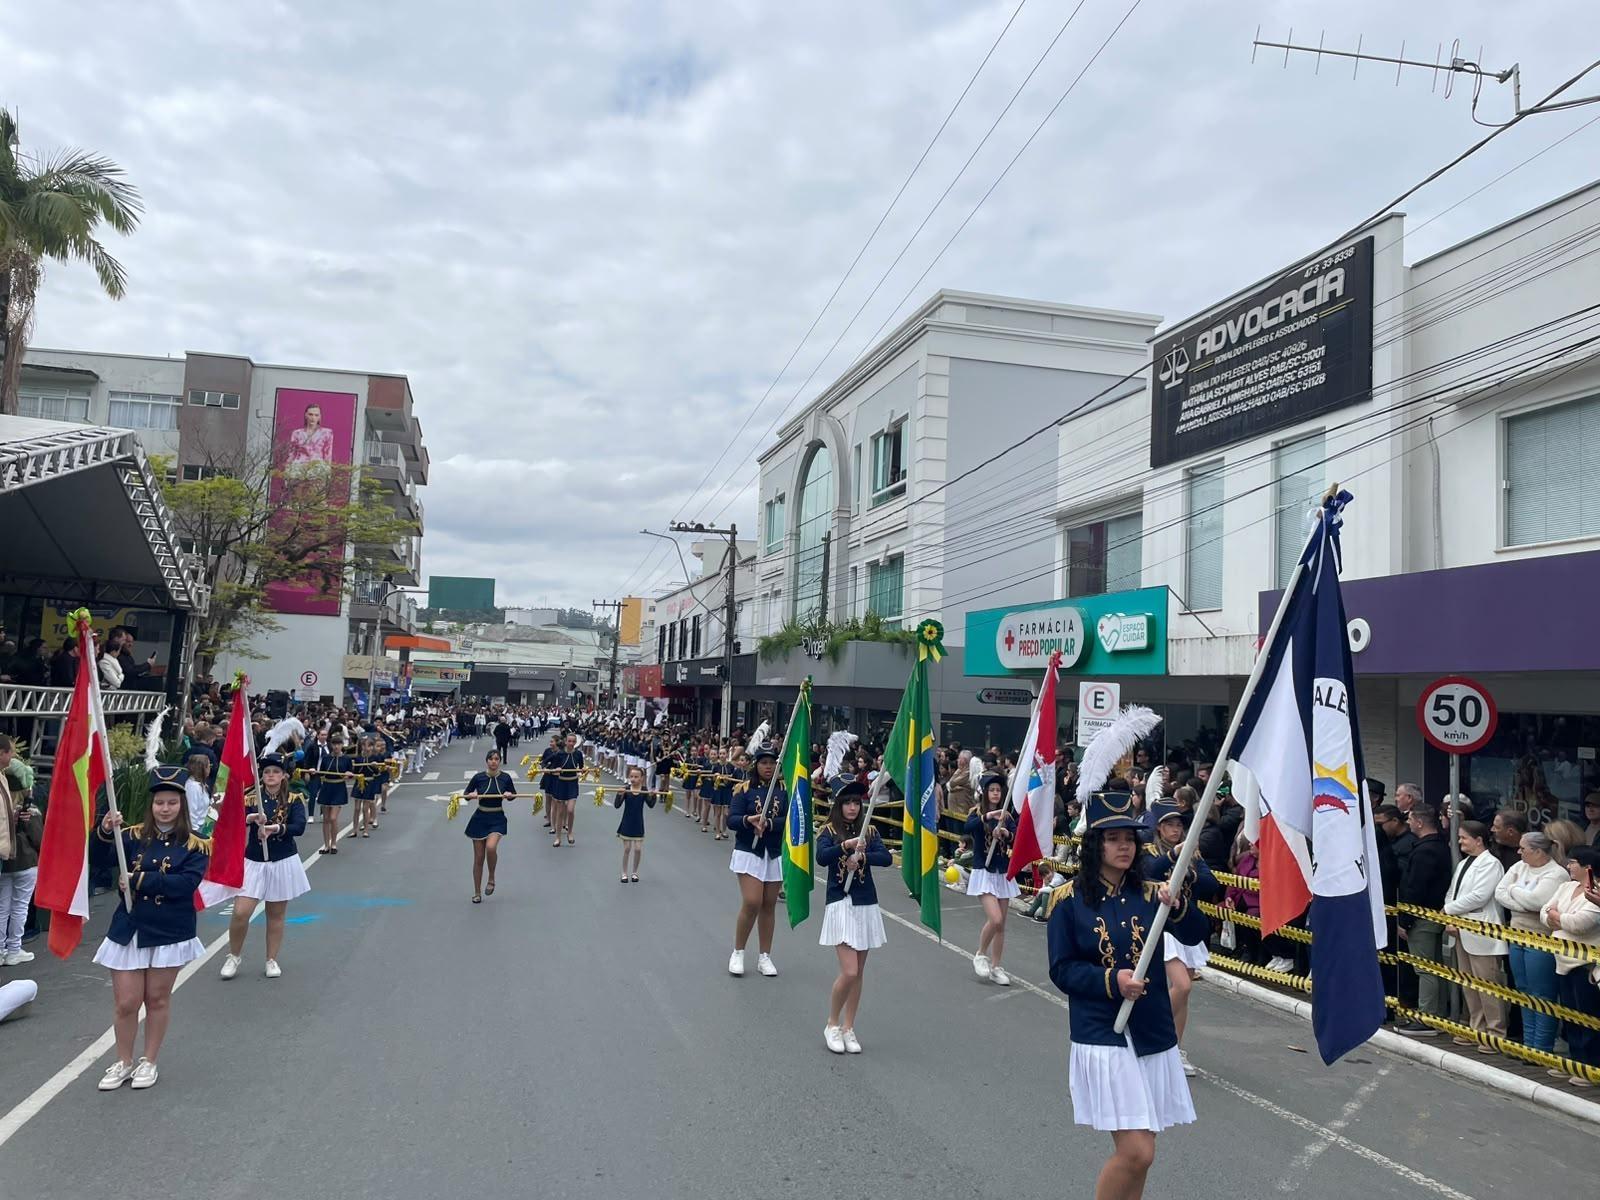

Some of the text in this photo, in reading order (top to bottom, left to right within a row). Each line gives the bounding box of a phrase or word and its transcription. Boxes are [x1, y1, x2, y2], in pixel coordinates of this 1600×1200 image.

[1195, 267, 1345, 360] ADVOCACIA
[1274, 313, 1318, 339] ASSOCIADOS
[1244, 368, 1268, 385] ALVES
[1020, 617, 1075, 636] FARMÁCIA
[1122, 621, 1145, 633] ESPAÇO
[1122, 631, 1145, 643] CUIDAR
[306, 674, 313, 683] E
[1094, 690, 1105, 709] E
[1432, 694, 1482, 728] 50
[1444, 731, 1469, 740] km/h
